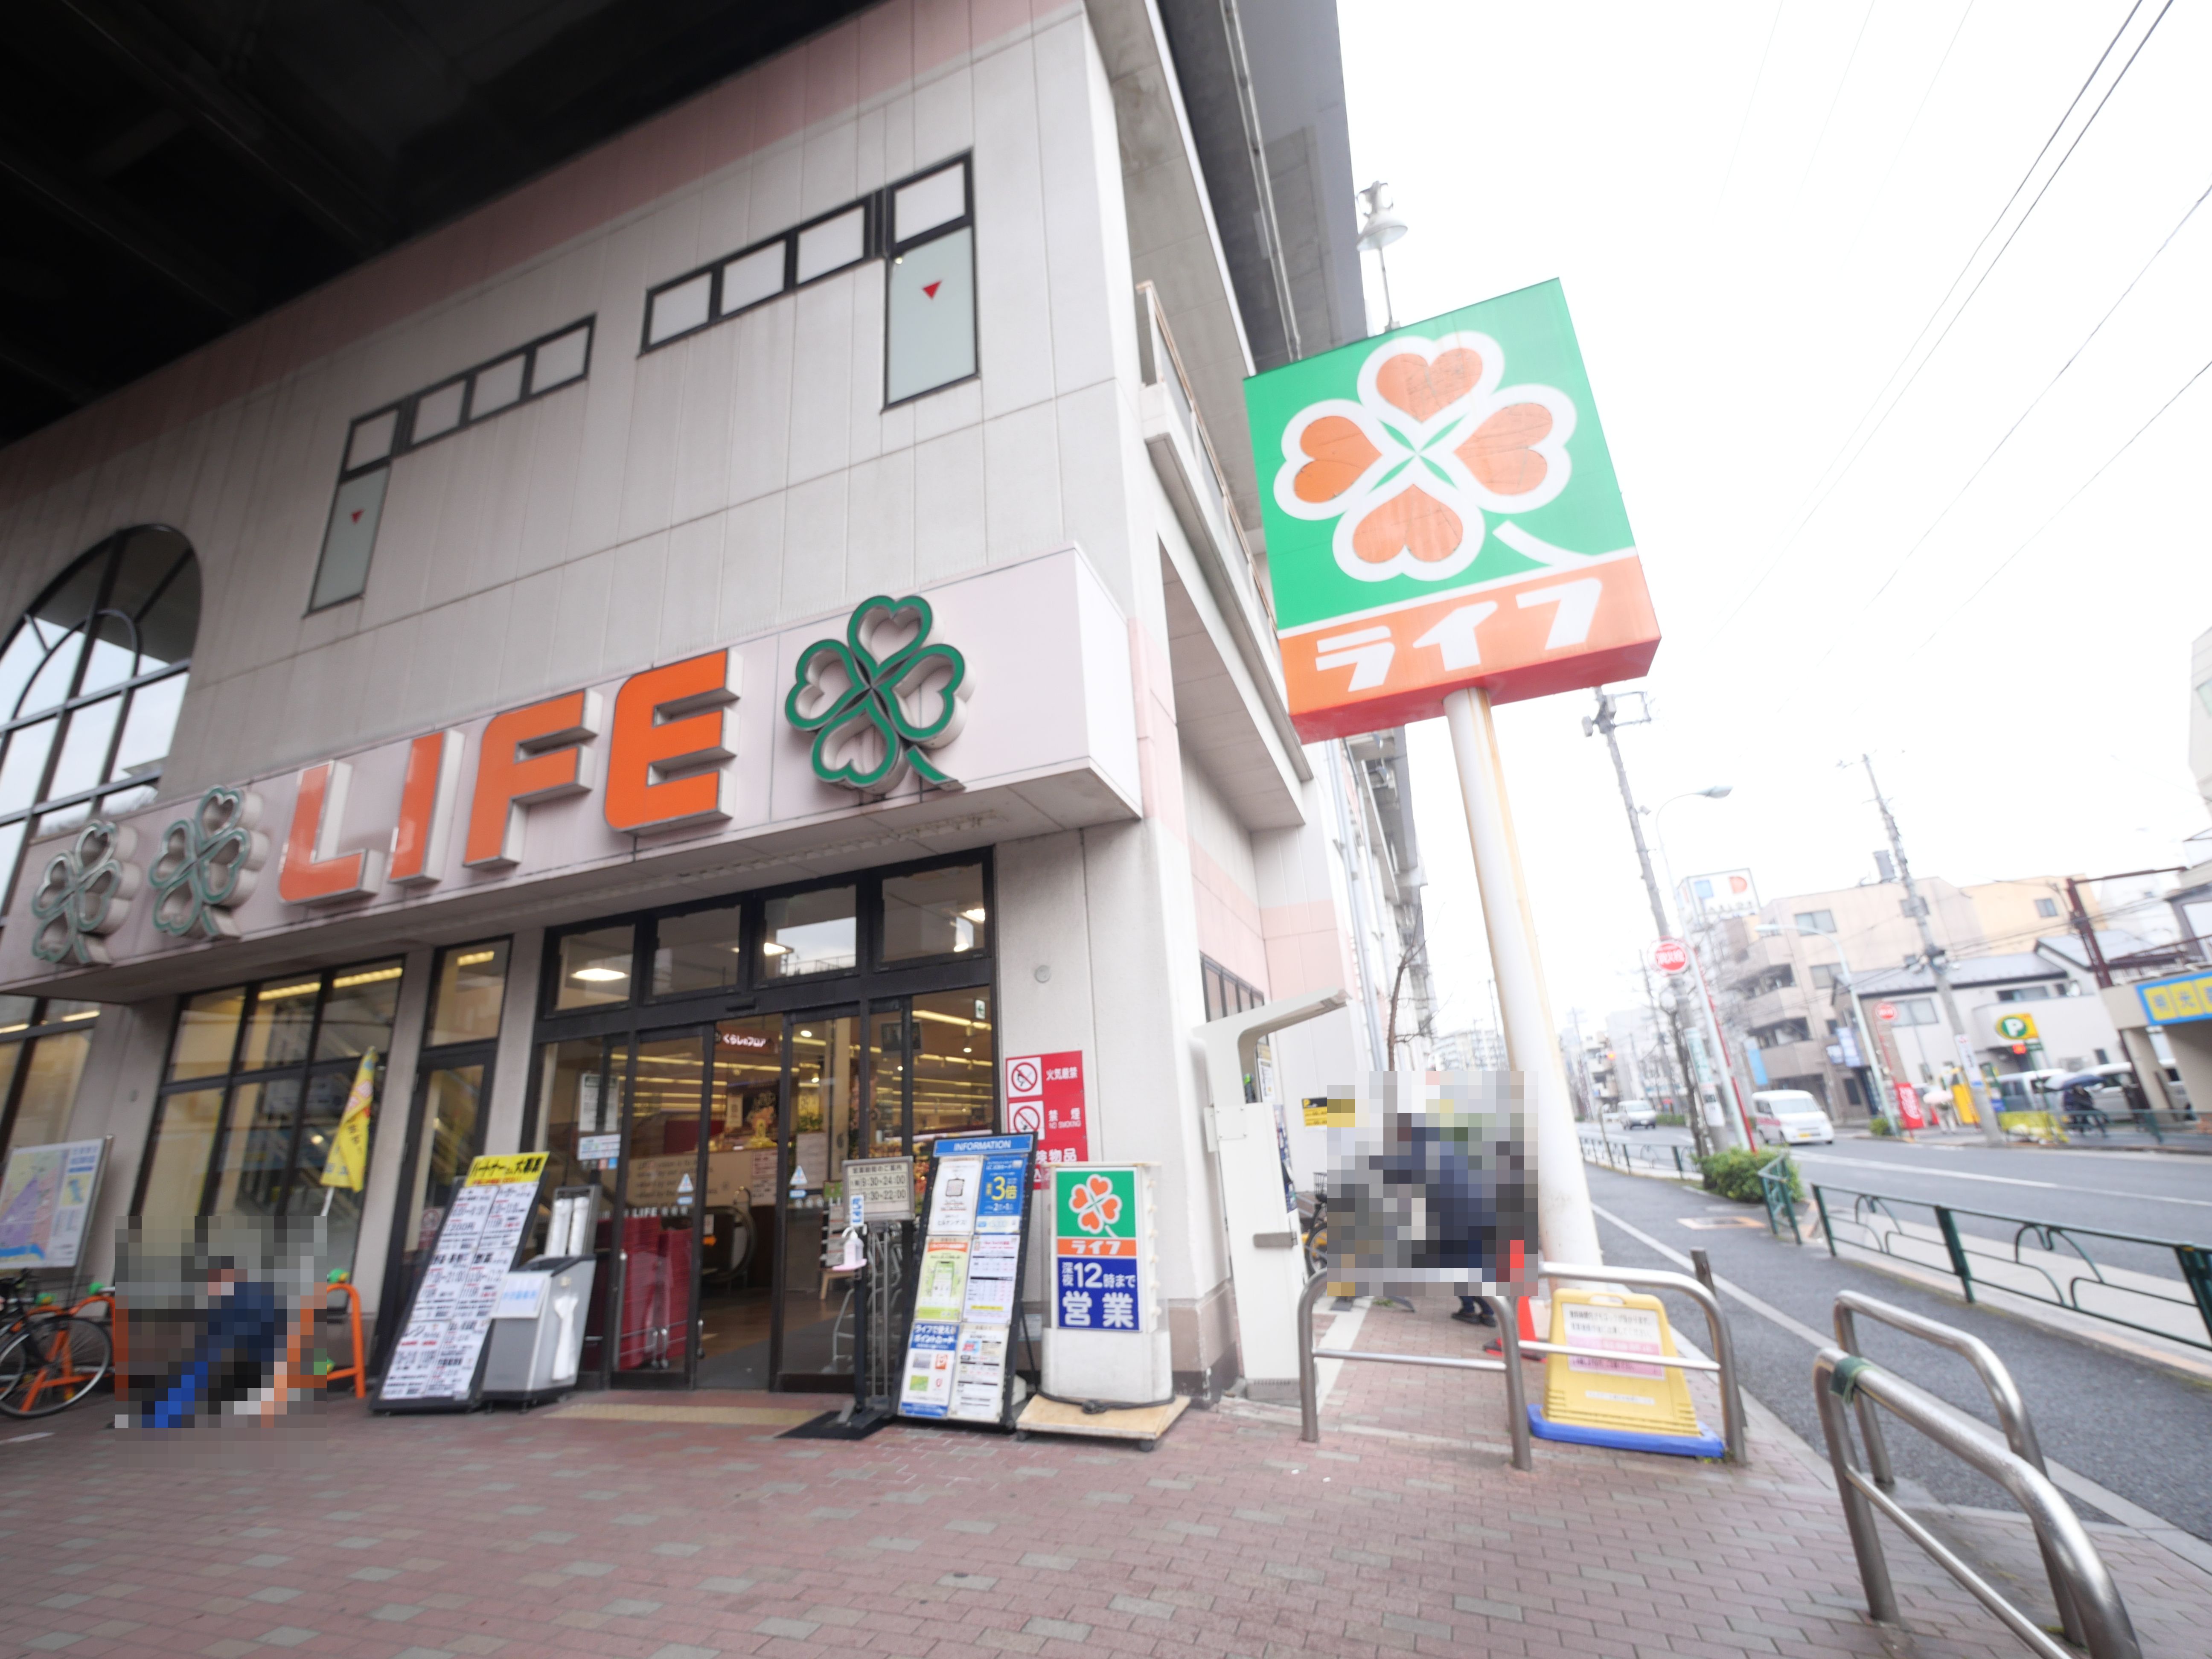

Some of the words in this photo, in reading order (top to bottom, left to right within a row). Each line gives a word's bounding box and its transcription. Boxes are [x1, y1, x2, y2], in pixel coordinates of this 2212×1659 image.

[1315, 577, 1602, 692] ライフ
[278, 648, 735, 905] LIFE
[2004, 1019, 2025, 1037] P
[1046, 1066, 1078, 1081] 火気厳禁
[953, 1140, 1012, 1151] INFORMATION
[1036, 1147, 1077, 1162] 険物品
[1071, 1240, 1122, 1255] ライフ
[1062, 1290, 1134, 1328] 営業
